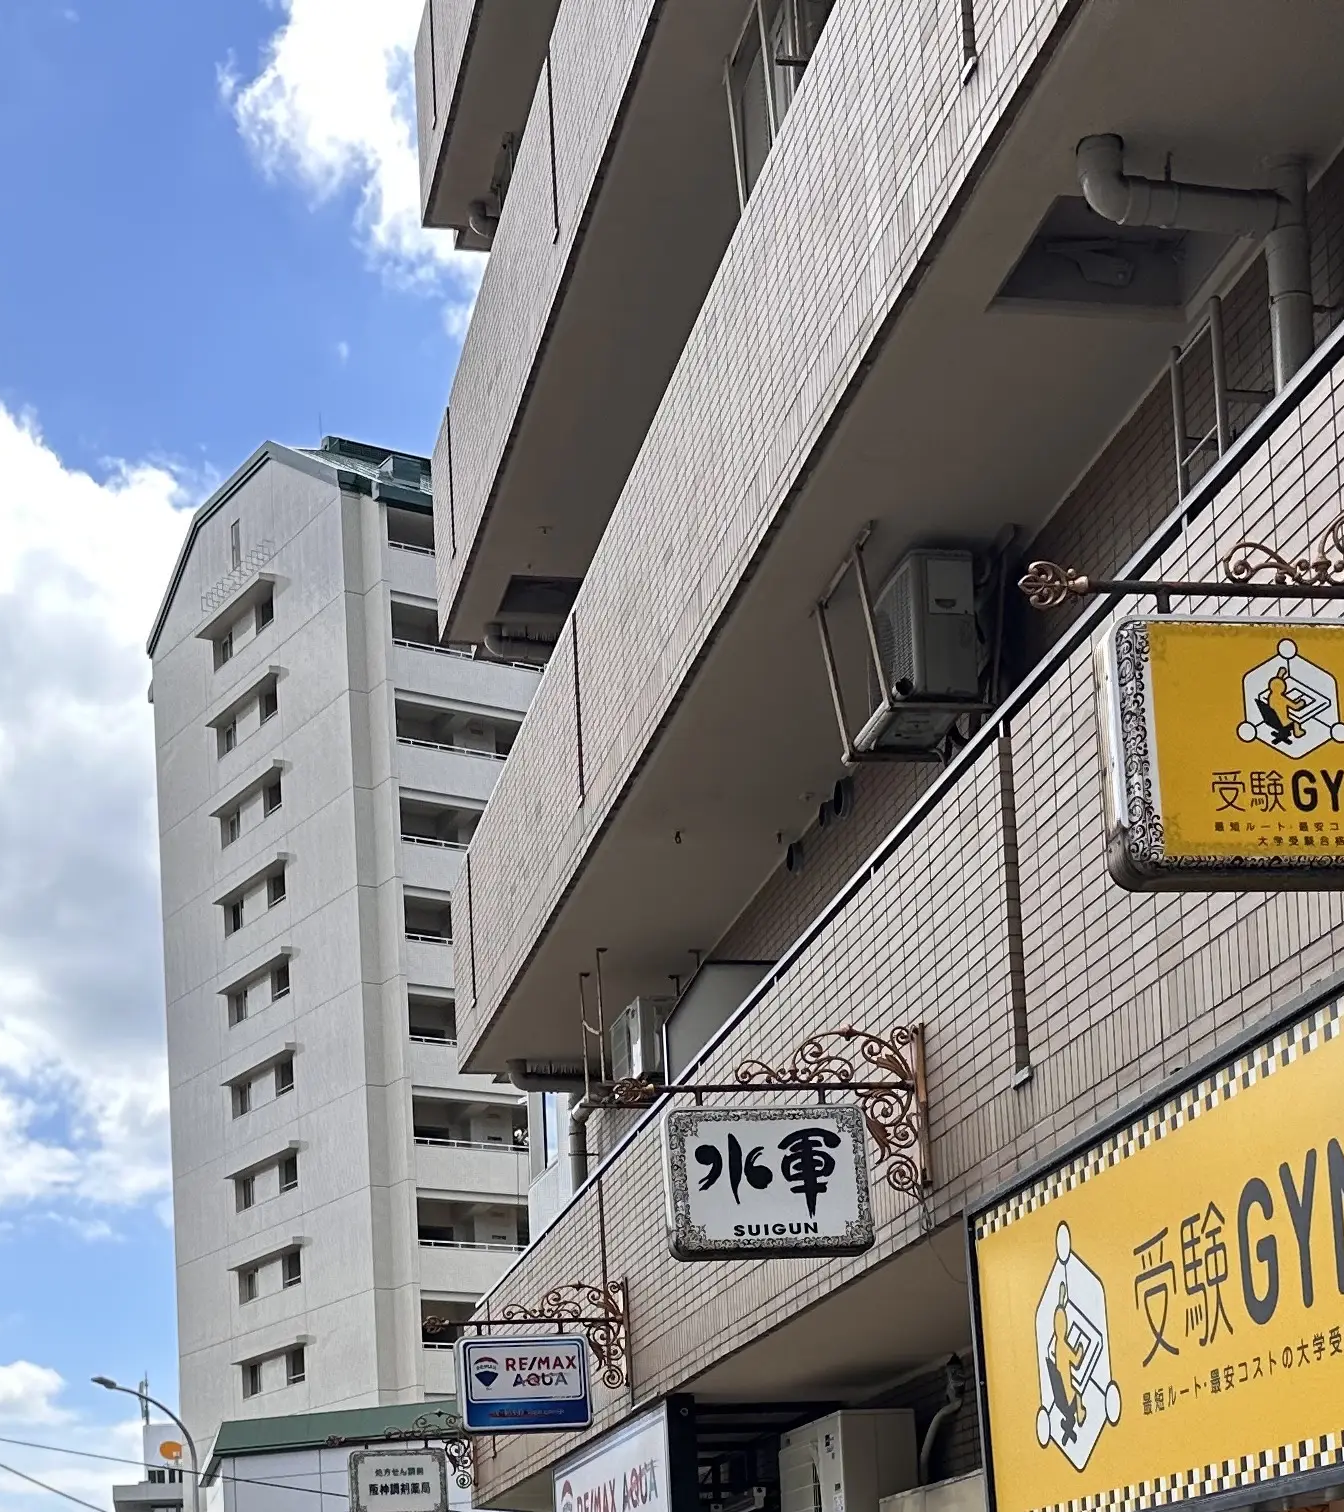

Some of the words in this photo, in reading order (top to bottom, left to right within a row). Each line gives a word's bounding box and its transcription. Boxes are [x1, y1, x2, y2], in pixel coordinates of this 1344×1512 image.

[695, 1128, 841, 1219] 水軍
[734, 1222, 818, 1236] SUIGUN
[505, 1355, 577, 1371] RE/MAX
[513, 1372, 568, 1387] AQUA
